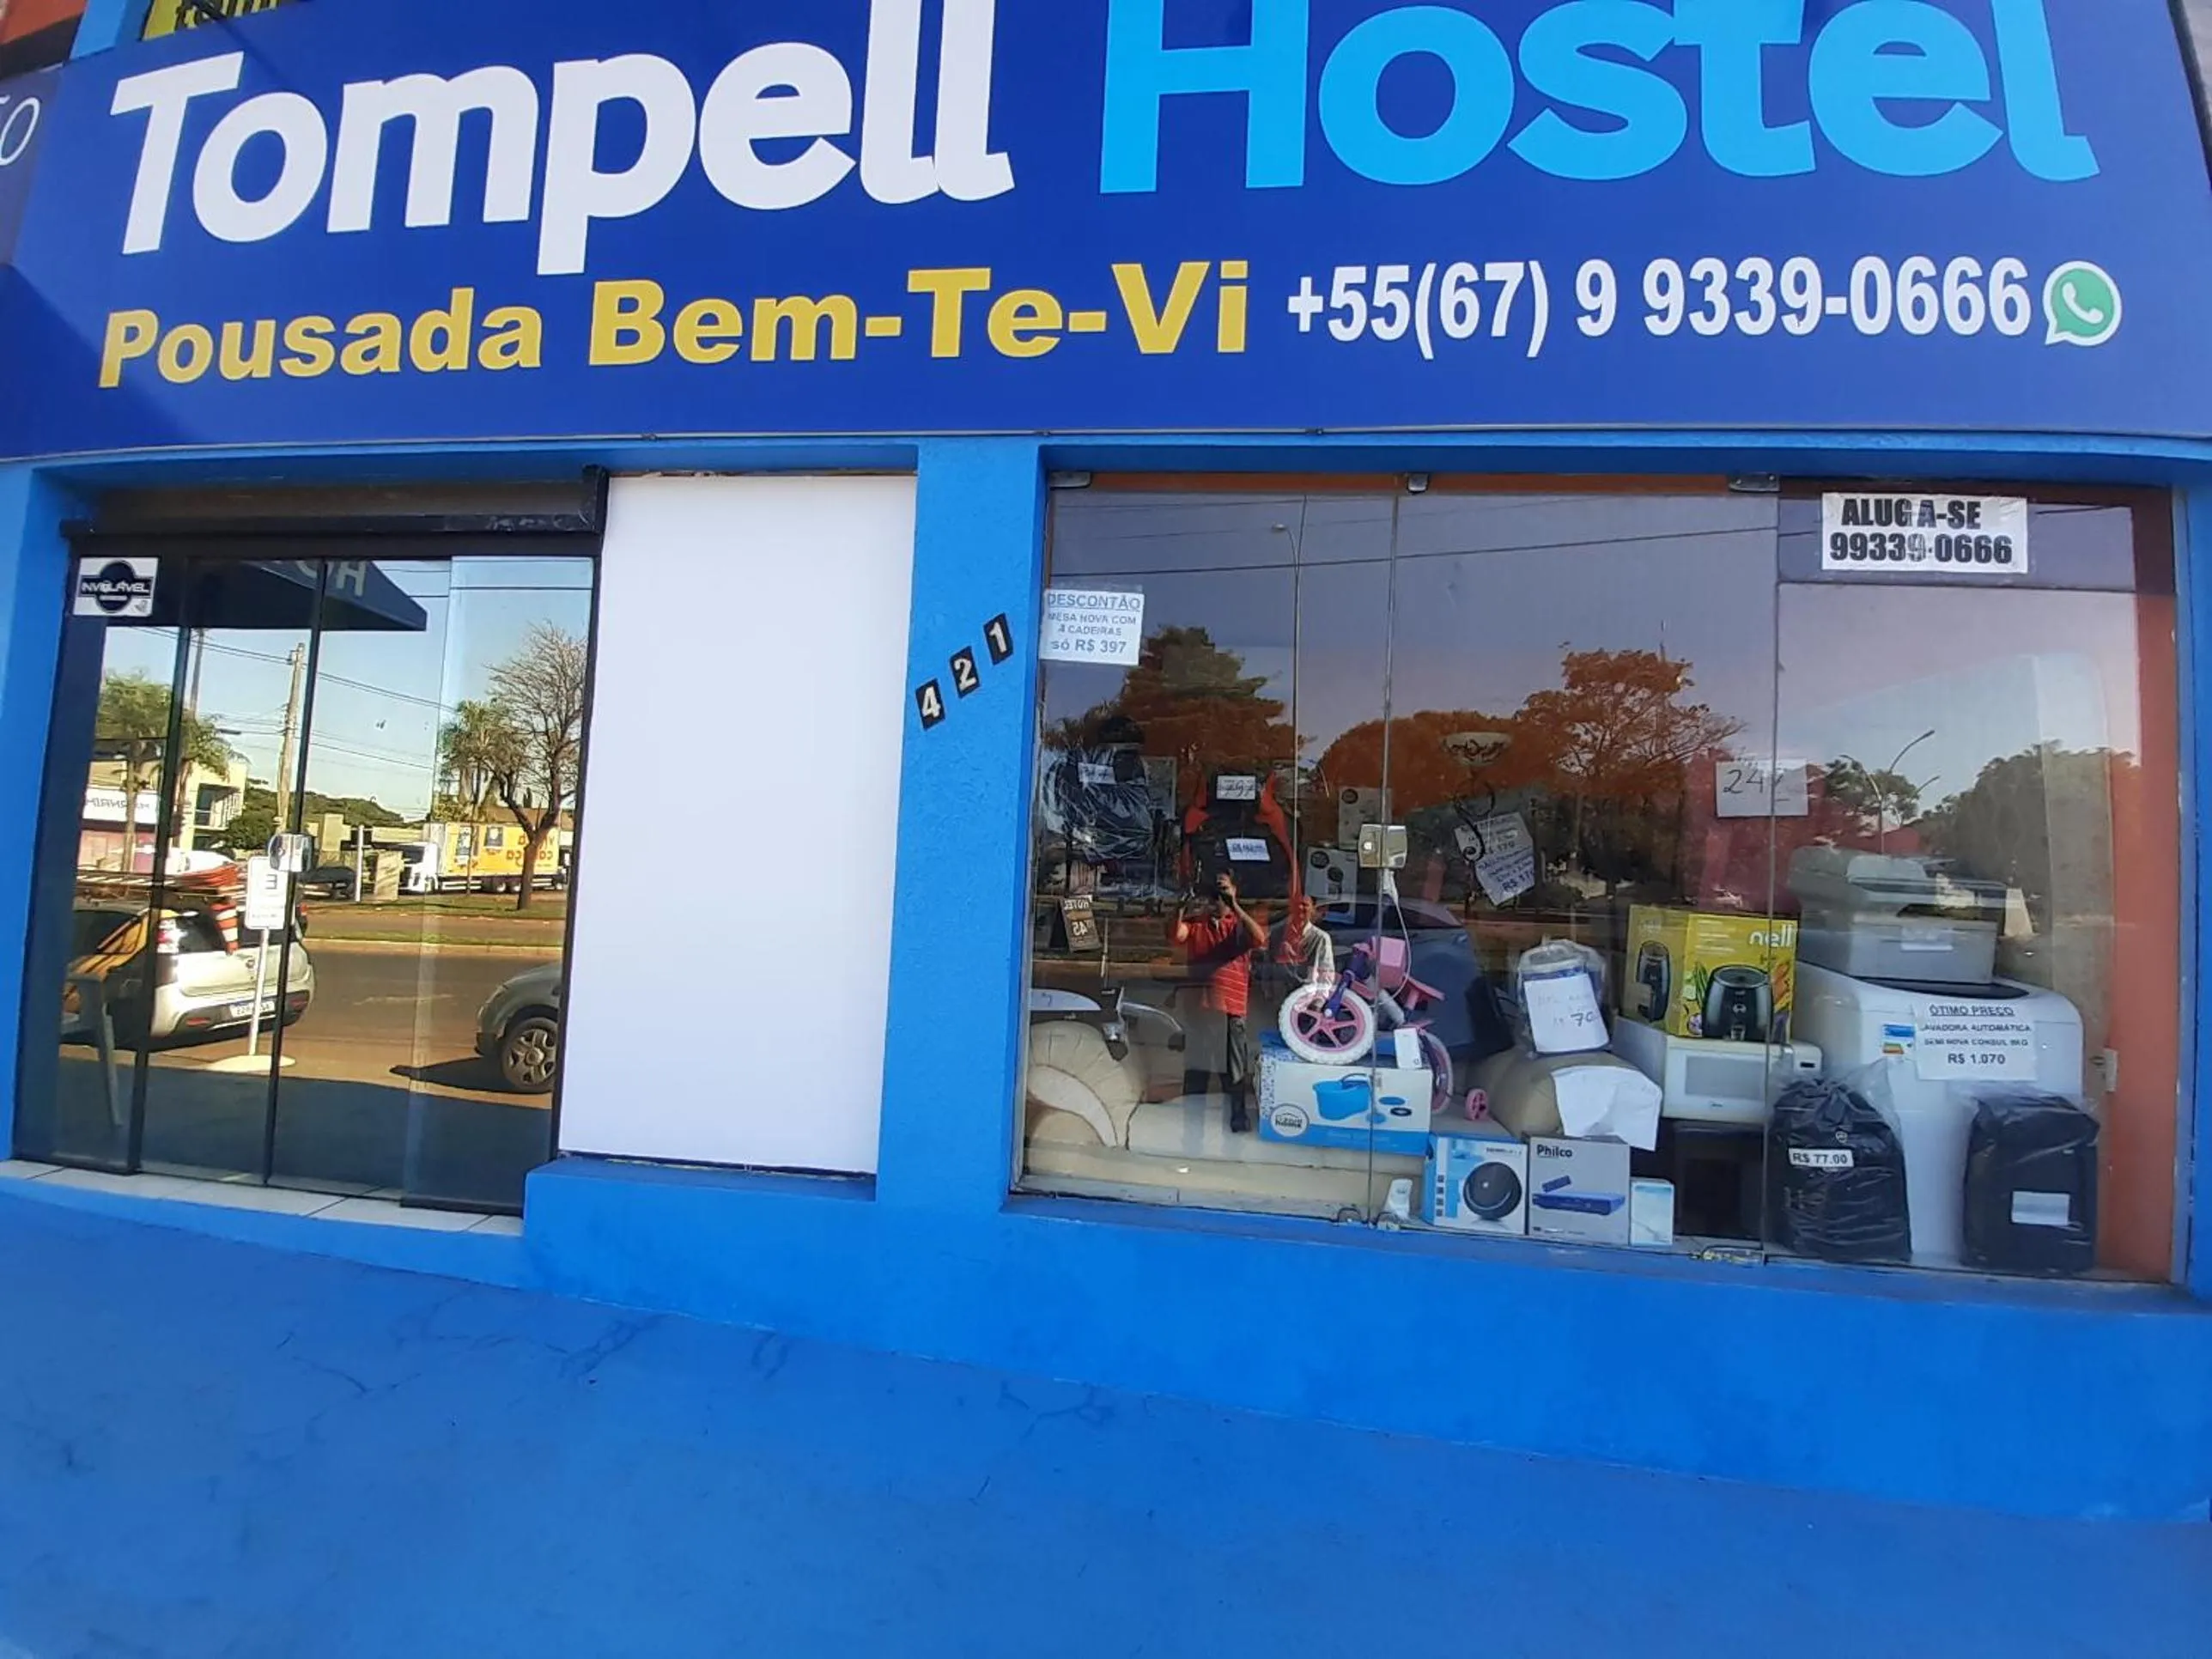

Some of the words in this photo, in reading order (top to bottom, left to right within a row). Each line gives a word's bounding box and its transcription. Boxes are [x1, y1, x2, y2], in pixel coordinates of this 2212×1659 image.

[110, 0, 1015, 276] Tompell
[1099, 0, 2100, 194] Hostel
[99, 287, 543, 389] Pousada
[588, 260, 1249, 367] Bem-Te-Vi
[1288, 259, 1549, 360] +55(67)
[1576, 259, 1617, 337] 9
[1643, 255, 2033, 337] 9339-0666
[1842, 498, 1981, 530] ALUGA-SE
[1048, 592, 1141, 611] DESCONTÃO
[1112, 616, 1136, 625] COM
[1068, 625, 1121, 635] CADEIRAS
[1075, 639, 1095, 653] R$
[1100, 641, 1127, 653] 397
[1749, 923, 1793, 947] nell
[1929, 1003, 1968, 1016] ÓTIMO
[1948, 1054, 1966, 1065] R$
[1970, 1054, 2006, 1065] 1.070
[1537, 1144, 1572, 1158] Philco
[1792, 1152, 1809, 1163] R$
[1813, 1154, 1848, 1164] 77.00
